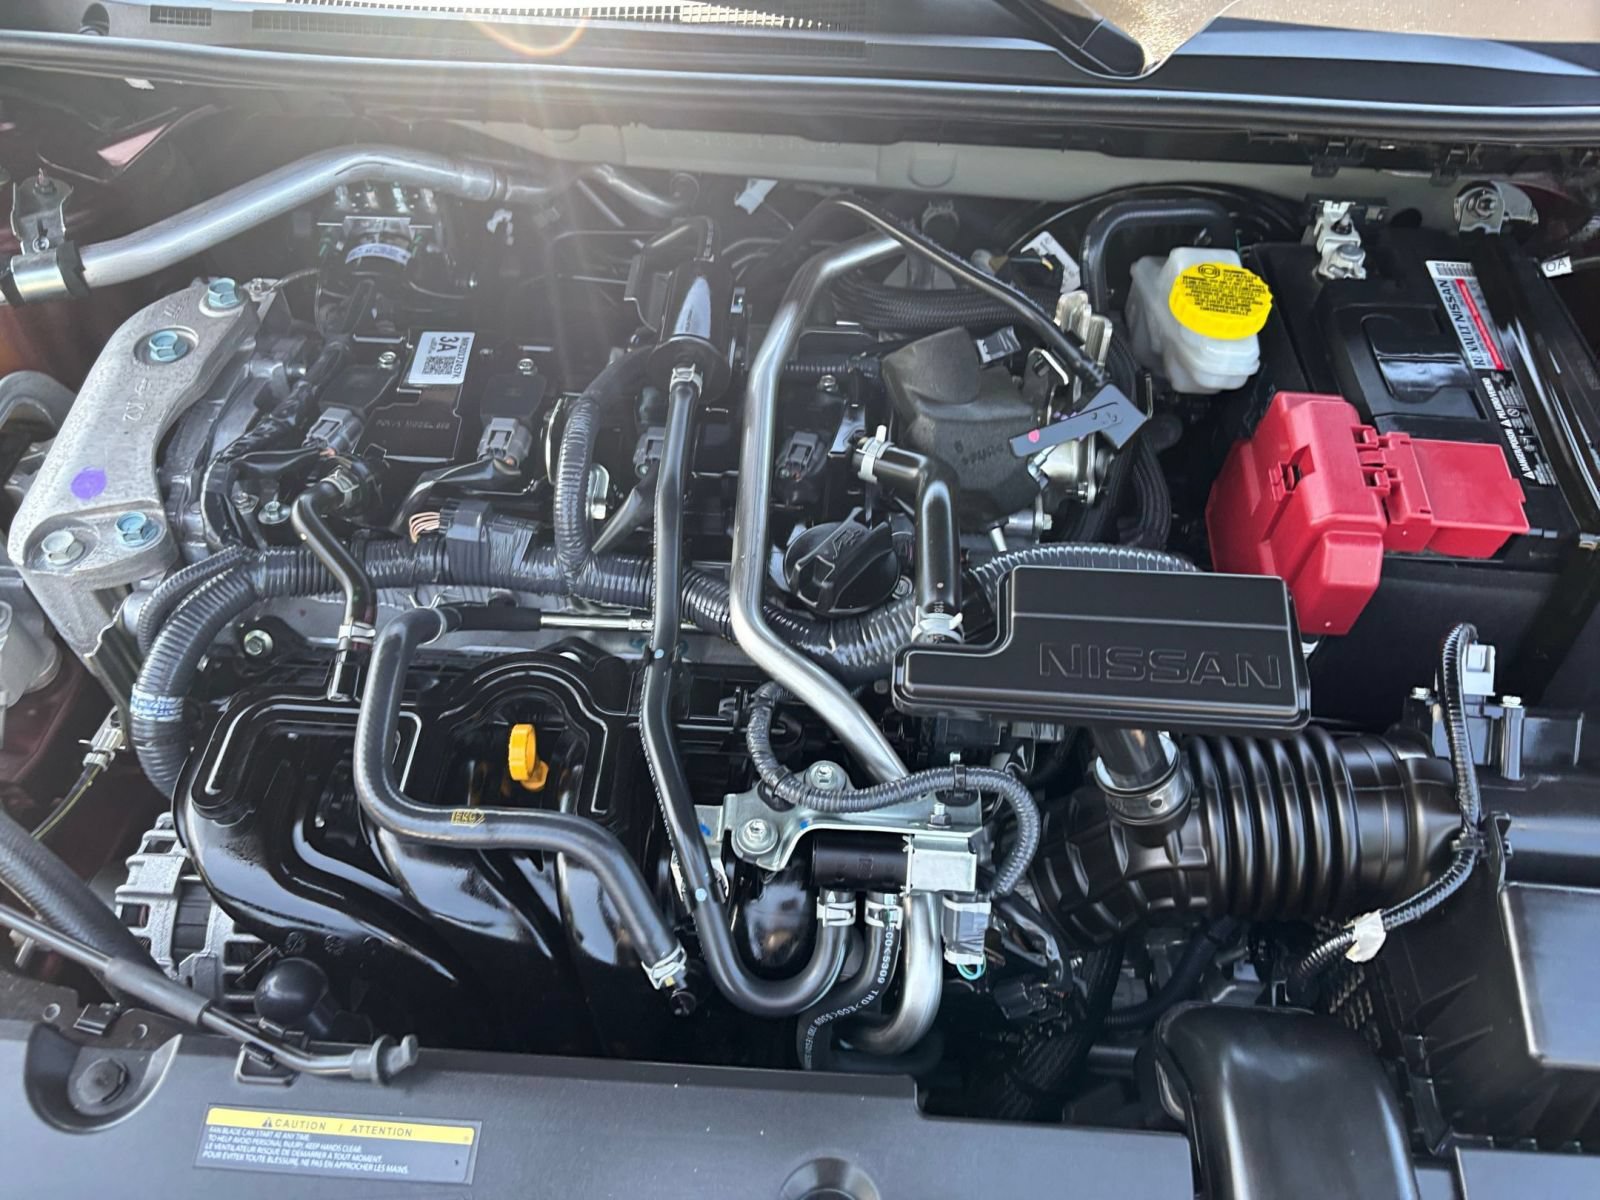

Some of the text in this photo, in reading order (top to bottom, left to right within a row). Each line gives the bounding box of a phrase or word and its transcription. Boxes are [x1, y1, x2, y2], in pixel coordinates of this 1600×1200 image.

[1437, 279, 1466, 322] NISSAN
[438, 336, 459, 353] 3A
[1039, 642, 1282, 690] NISSAN
[208, 1126, 222, 1135] FAN
[222, 1127, 242, 1136] BLADE
[241, 1129, 256, 1137] CAN
[255, 1129, 275, 1138] START
[282, 1132, 296, 1140] ANY
[275, 1118, 326, 1131] CAUTION
[351, 1125, 413, 1138] ATTENTION
[213, 1143, 257, 1153] VENTILATEUR
[256, 1146, 280, 1156] RISQUE
[333, 1152, 351, 1161] TOUT
[216, 1135, 233, 1143] HELP
[231, 1136, 252, 1145] AVOID
[252, 1138, 282, 1148] PERSONAL
[304, 1142, 321, 1150] KEEP
[320, 1143, 342, 1152] HANDS
[202, 1150, 222, 1159] POUR
[244, 1153, 266, 1163] TOUTE
[299, 1158, 311, 1167] NE
[310, 1159, 324, 1168] PAS
[322, 1160, 335, 1169] EN
[334, 1161, 374, 1172] APPROCHER
[373, 1163, 387, 1173] LES
